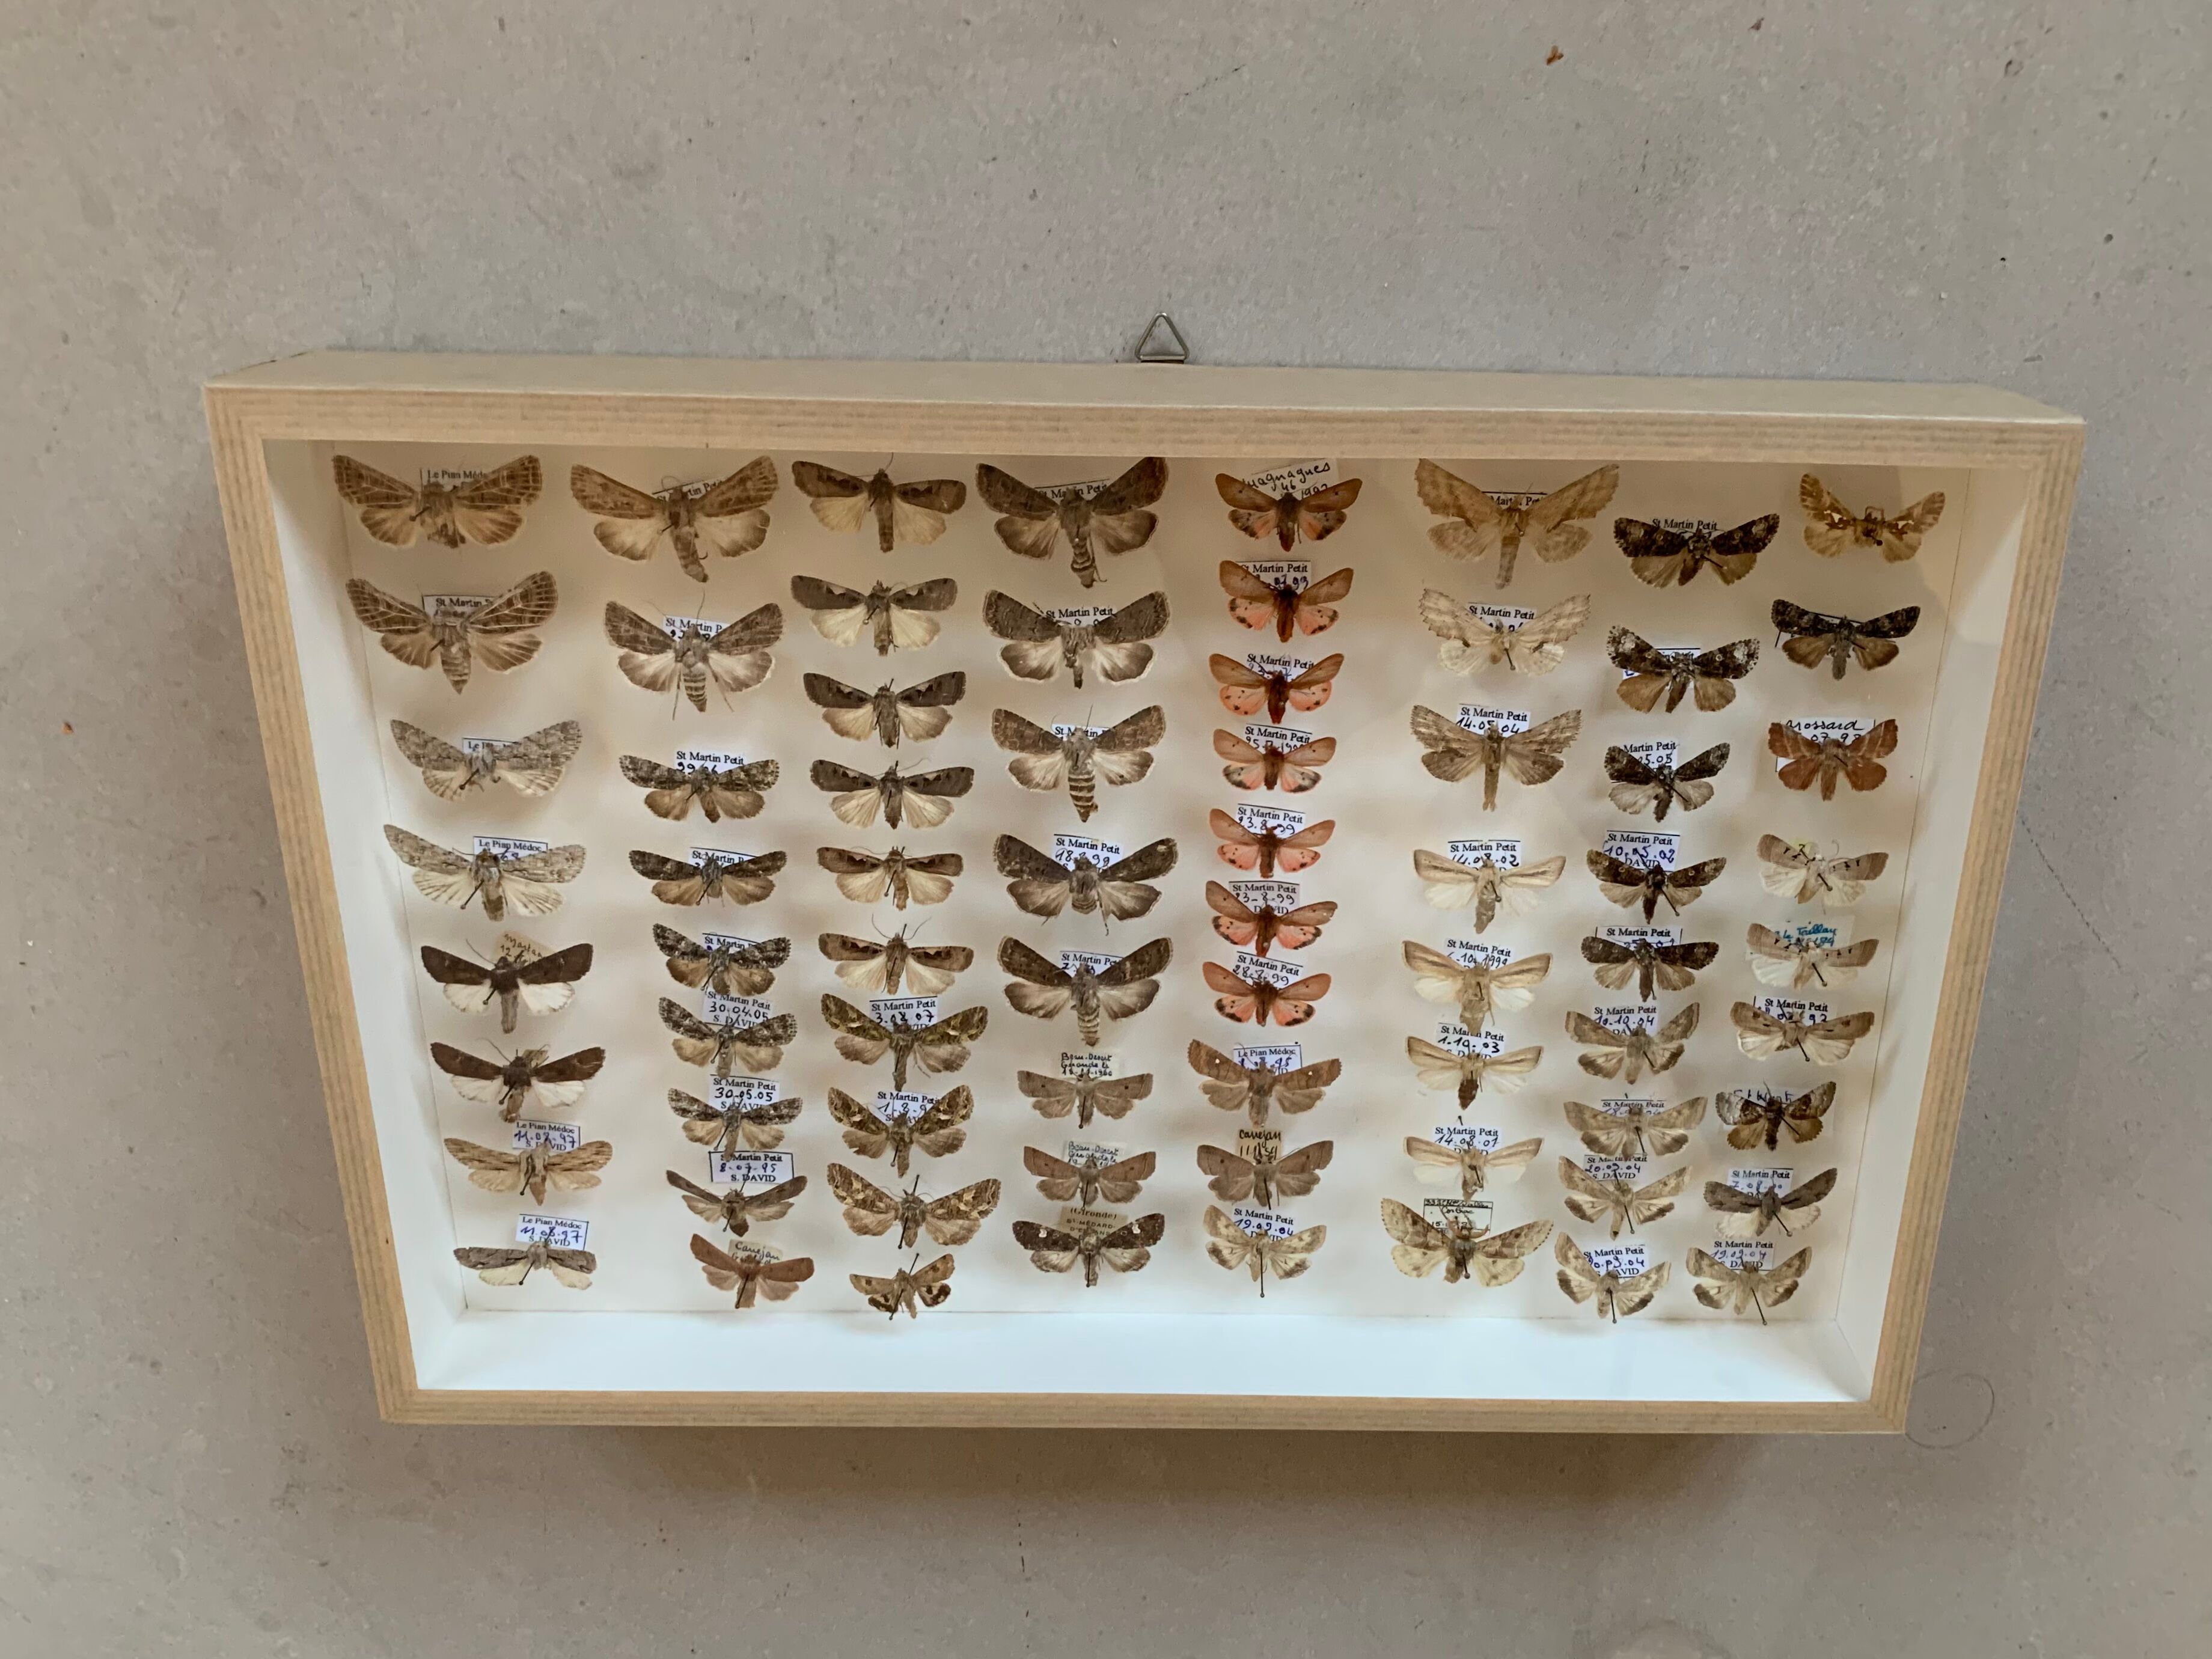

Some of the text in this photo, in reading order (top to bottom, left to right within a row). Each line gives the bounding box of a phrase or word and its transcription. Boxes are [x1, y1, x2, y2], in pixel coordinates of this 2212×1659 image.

[428, 470, 439, 478] Le
[1652, 518, 1717, 530] St Martin Petit
[1253, 563, 1307, 572] Martin Petit
[436, 598, 446, 606] St
[450, 598, 481, 606] Martin
[1046, 606, 1113, 619] St Martin Petit
[1481, 608, 1511, 617] Martin
[1514, 610, 1534, 619] Petit
[666, 618, 676, 627] St
[680, 620, 712, 632] Matin
[1247, 653, 1256, 662] St
[1259, 655, 1291, 667] Martin
[1461, 707, 1527, 721] St Martin Petit
[1245, 726, 1310, 744] St Martin Petit
[1624, 741, 1676, 753] Martin Petit
[677, 751, 744, 765] St Martin Petit
[1238, 807, 1303, 823] St Martin Petit
[1620, 834, 1649, 843] Martin
[1653, 836, 1672, 845] Petit
[514, 842, 542, 851] Médoc
[1069, 839, 1098, 850] Martin
[1101, 843, 1120, 854] Petit
[1462, 843, 1492, 851] Martin
[1497, 843, 1517, 852] Petit
[692, 851, 702, 859] St
[1278, 885, 1297, 893] Petit
[704, 936, 713, 944] St
[717, 938, 745, 949] Martin
[1447, 939, 1511, 957] St Martin Petit
[1073, 955, 1101, 965] Martin
[1249, 958, 1277, 970] Martin
[1280, 965, 1299, 976] Petit
[720, 995, 749, 1004] Martin
[753, 999, 771, 1010] Petit
[884, 1001, 913, 1010] Martin
[917, 1000, 935, 1008] Petit
[1765, 998, 1828, 1012] St Martin Petit
[1606, 1007, 1634, 1015] Martin
[1485, 1031, 1504, 1041] Petit
[726, 1079, 754, 1088] Martin
[757, 1082, 776, 1090] Petit
[890, 1092, 918, 1102] Martin
[549, 1125, 575, 1133] Médoc
[1743, 1170, 1769, 1178] Martin
[1245, 1210, 1273, 1220] Martin
[1276, 1215, 1294, 1225] Petit
[555, 1220, 582, 1229] Médoc
[1595, 1248, 1623, 1257] Martin
